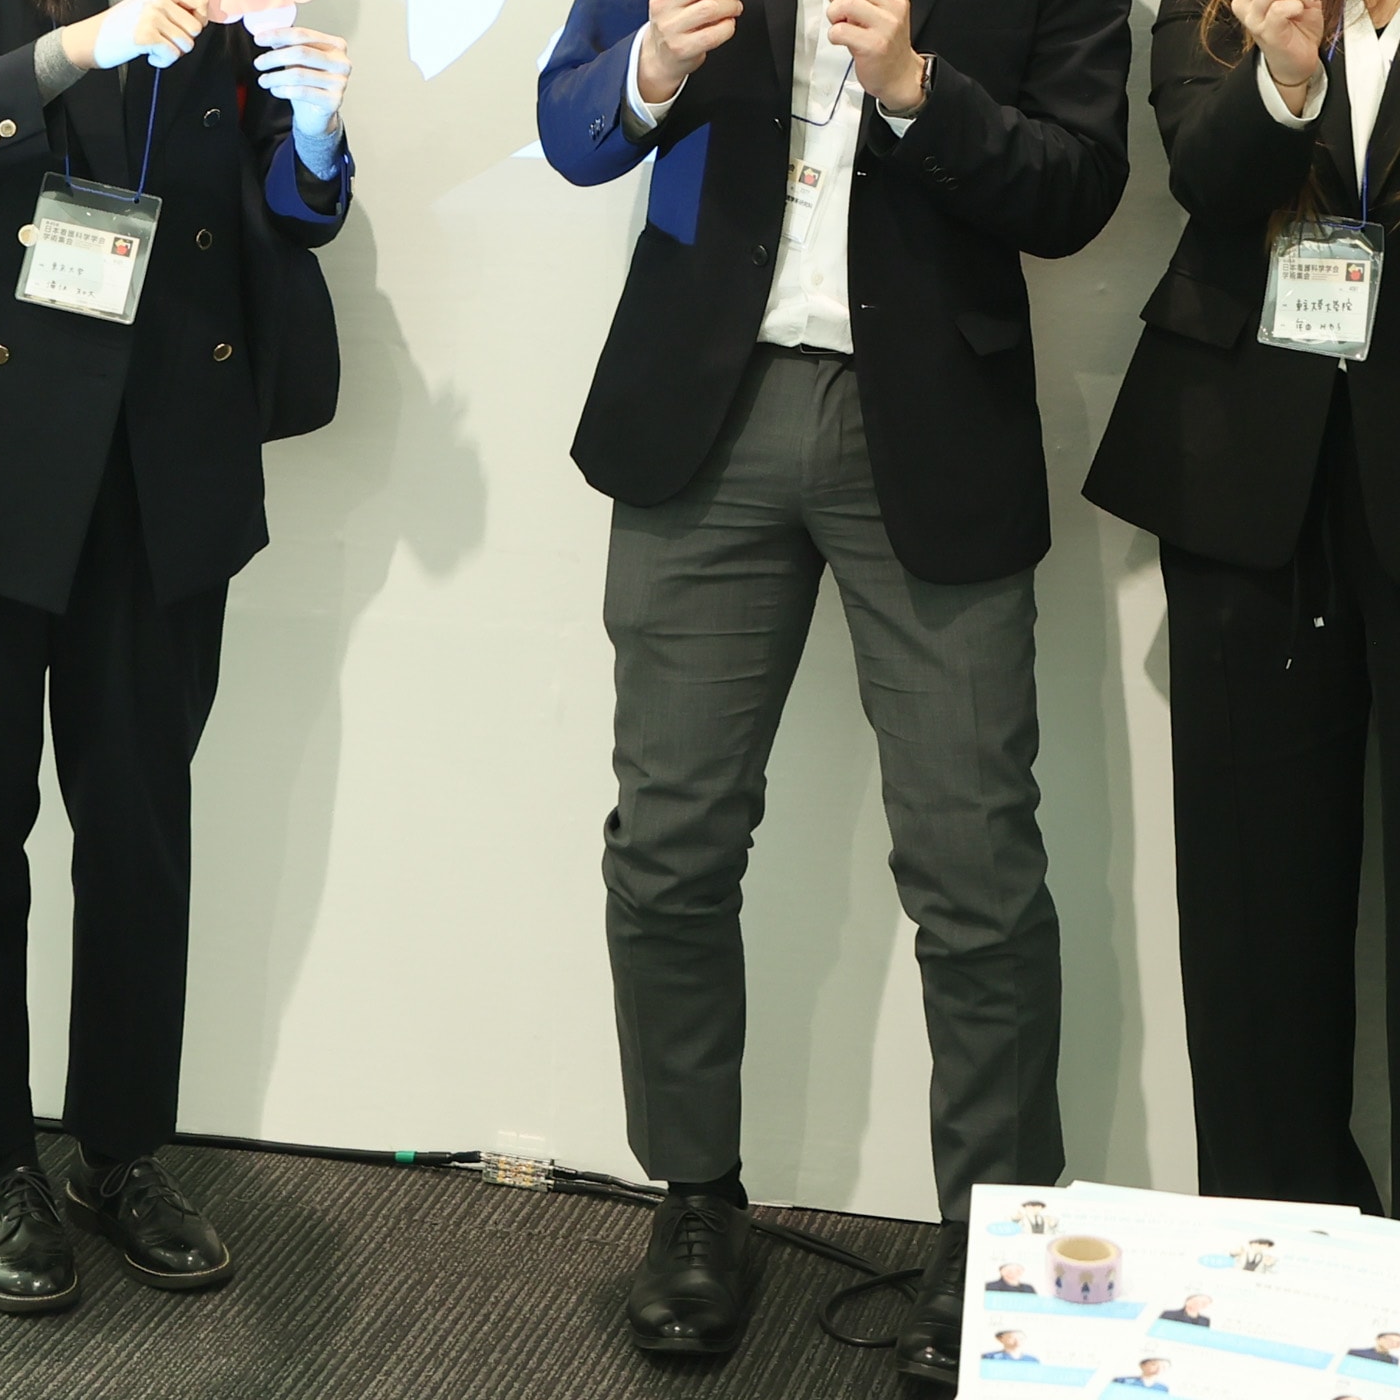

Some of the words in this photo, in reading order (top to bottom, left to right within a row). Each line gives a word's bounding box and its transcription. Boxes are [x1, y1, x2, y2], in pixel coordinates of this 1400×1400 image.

[42, 233, 74, 246] 学術集会
[43, 225, 106, 246] 日本看護科学学会
[1282, 263, 1340, 274] 日本看護科学学会
